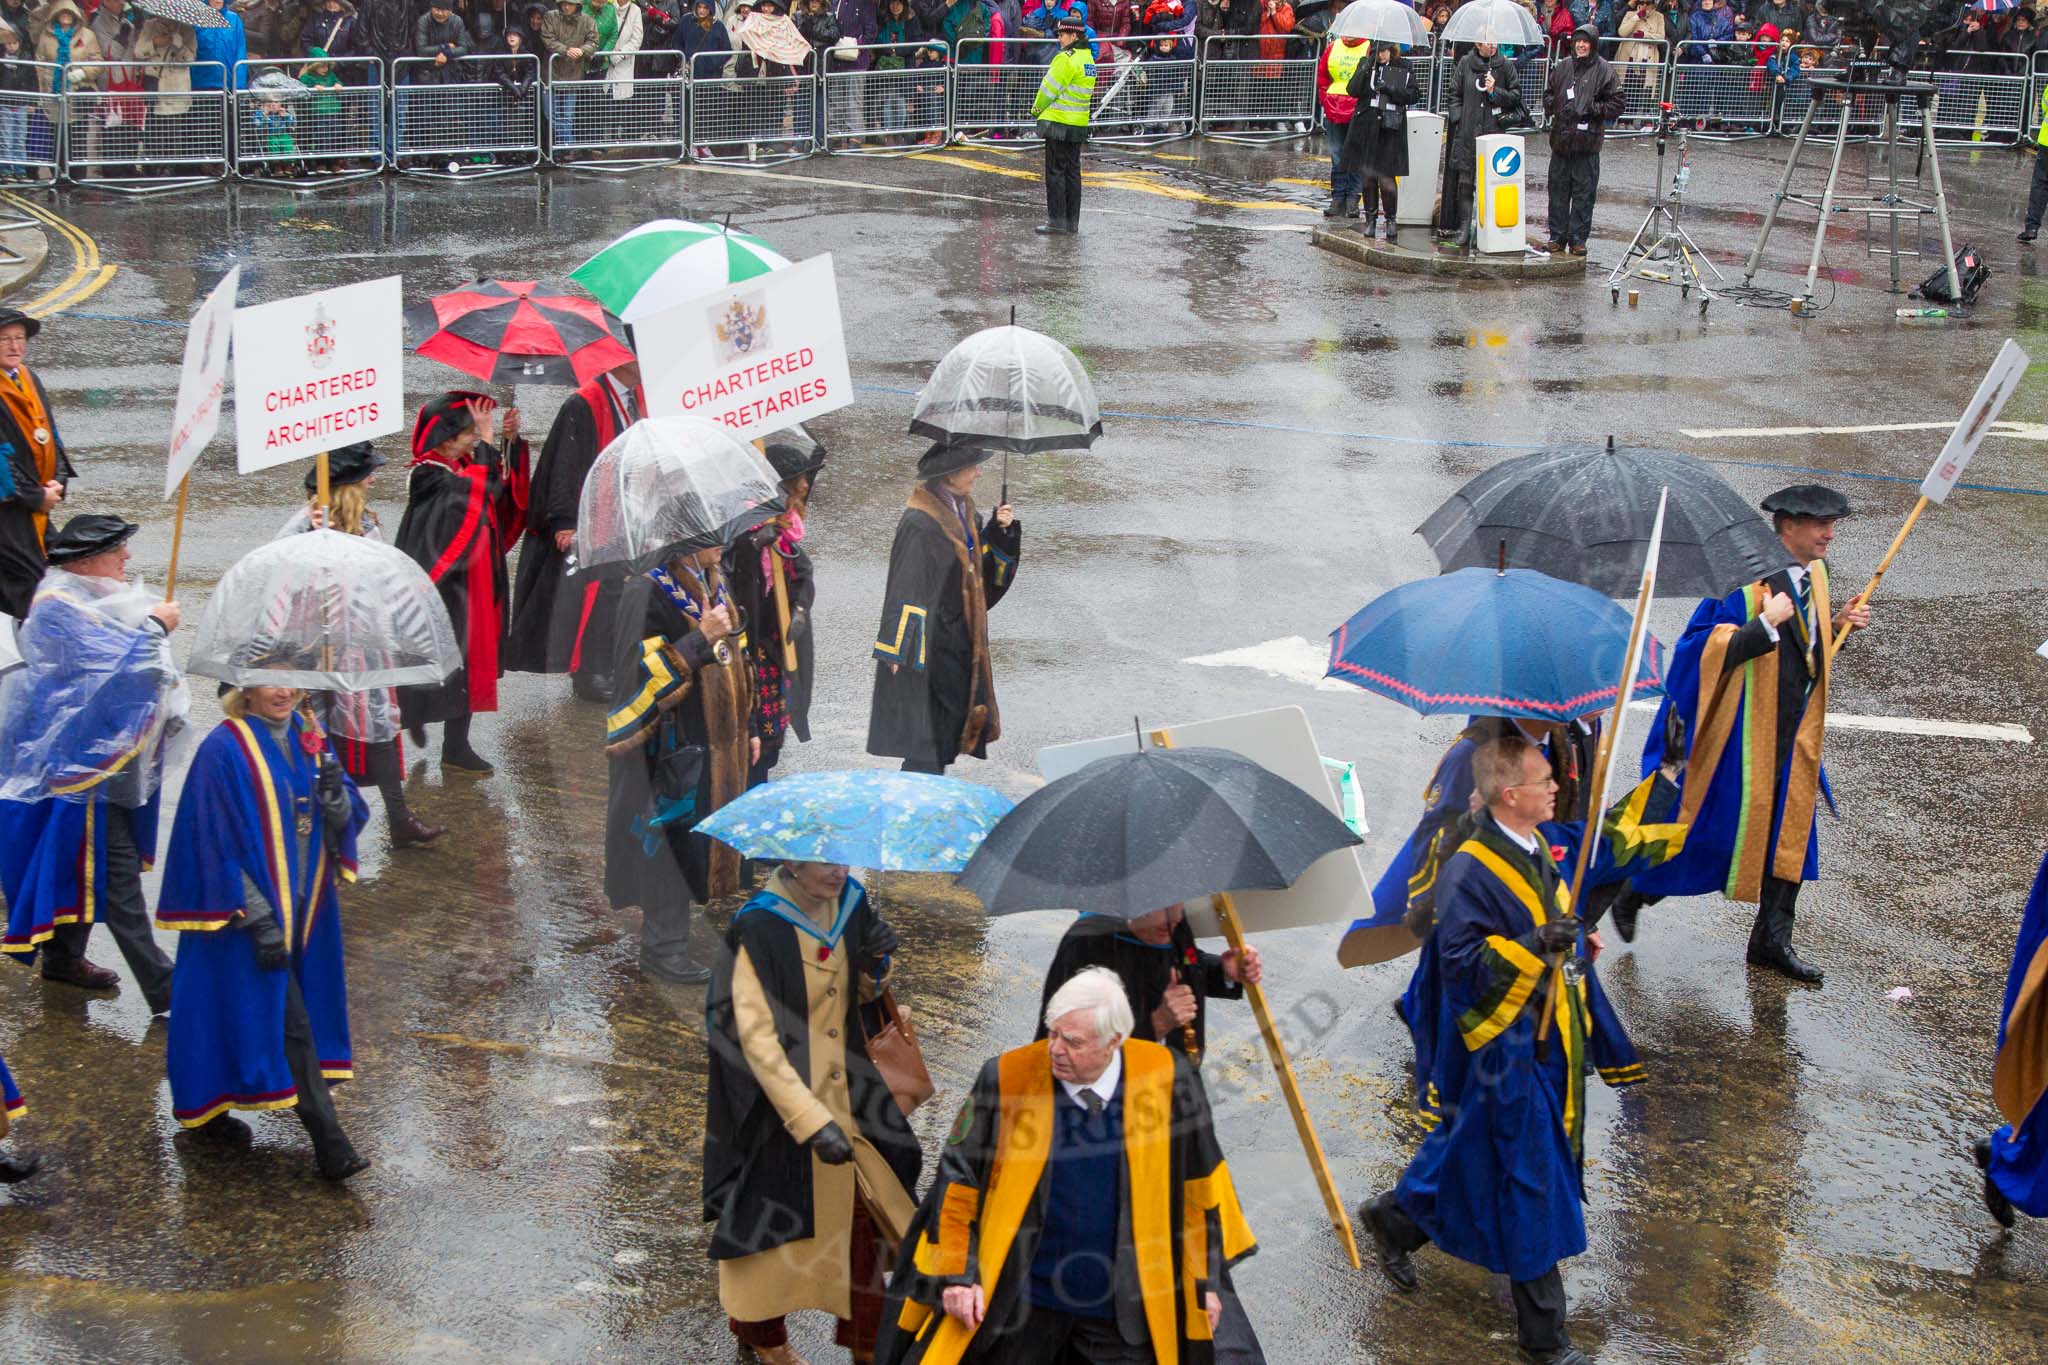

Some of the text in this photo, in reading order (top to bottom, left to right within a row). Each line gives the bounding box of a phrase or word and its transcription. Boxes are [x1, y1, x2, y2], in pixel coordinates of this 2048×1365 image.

[265, 367, 377, 413] CHARTERED
[681, 347, 814, 410] CHARTERED
[265, 402, 379, 450] ARCHITECTS
[712, 378, 828, 429] RETARIES
